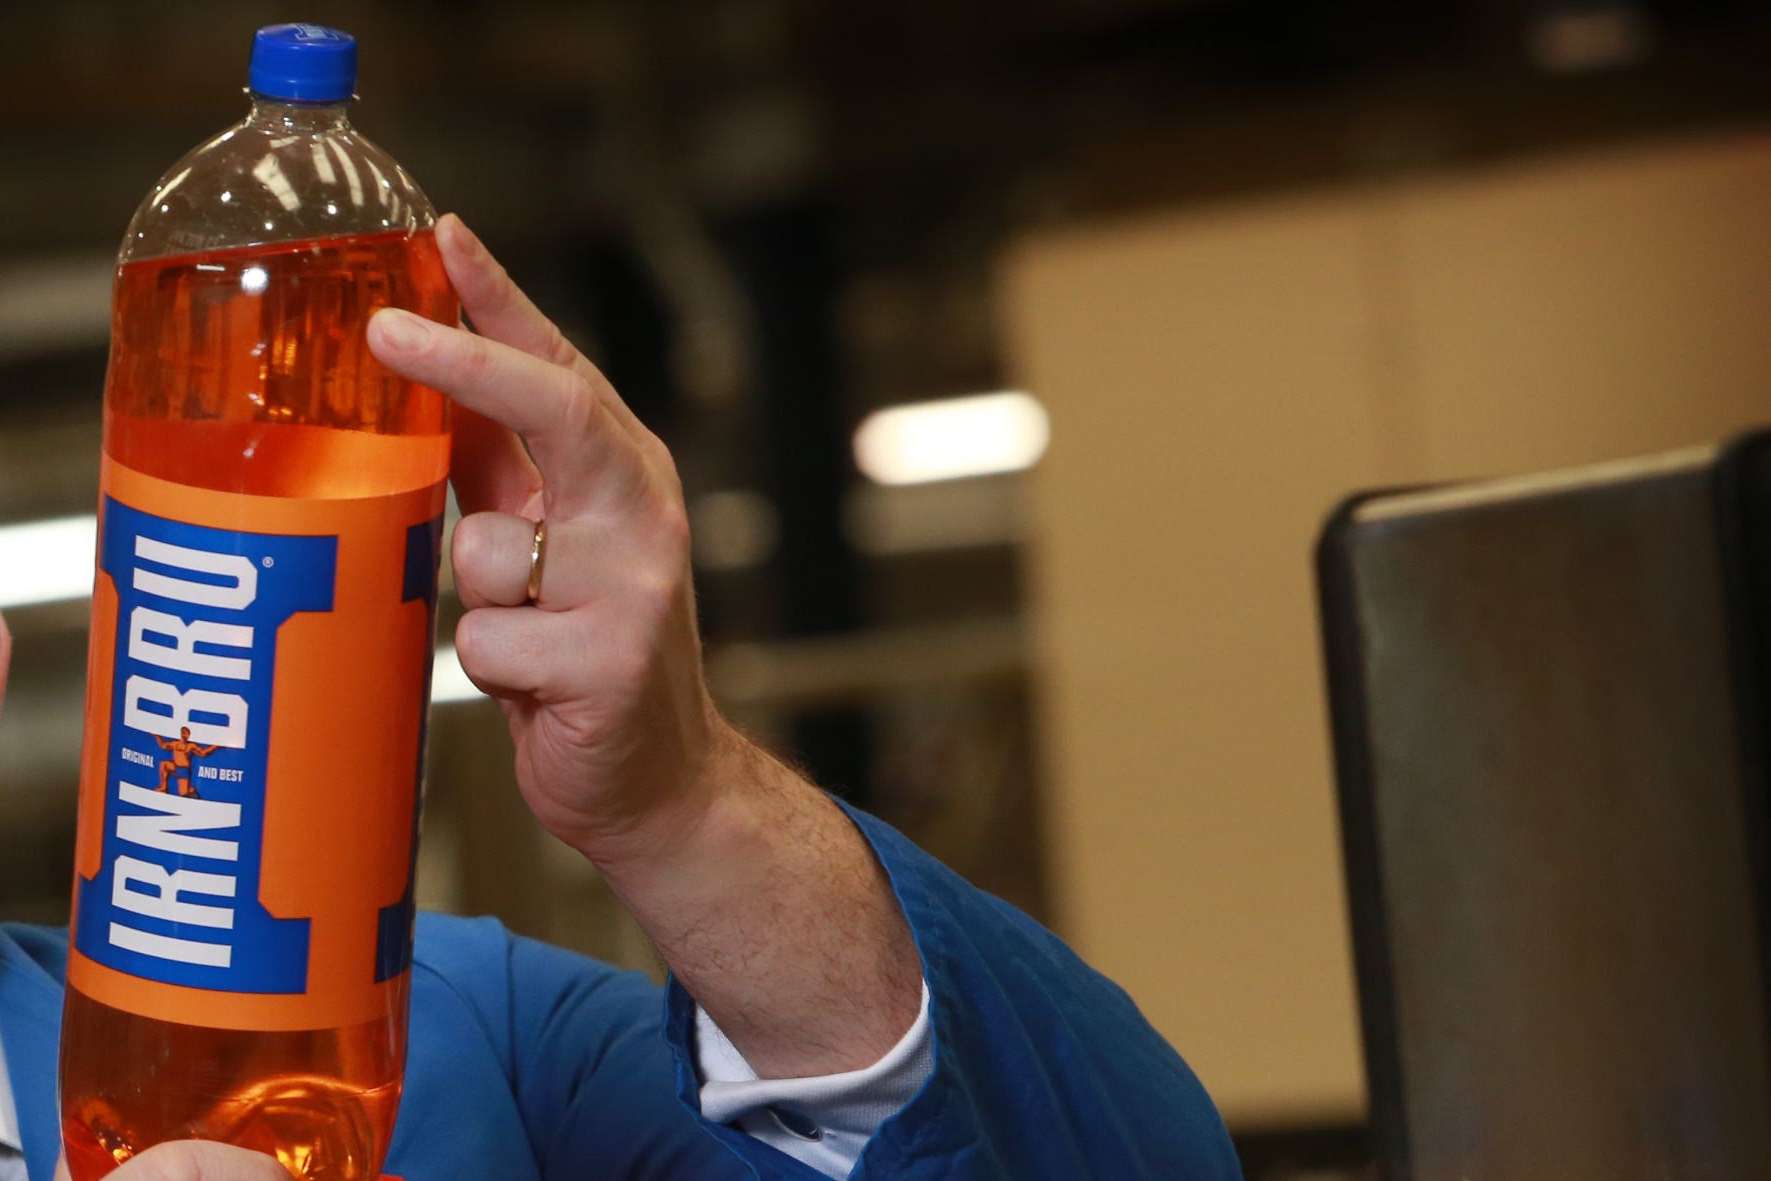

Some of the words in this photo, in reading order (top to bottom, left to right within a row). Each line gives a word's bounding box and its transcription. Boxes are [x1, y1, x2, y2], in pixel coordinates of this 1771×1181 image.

[124, 534, 258, 749] BRU
[121, 747, 155, 769] ORIGINAL
[197, 765, 218, 780] AND
[218, 768, 245, 783] BEST
[109, 780, 241, 968] IRN
